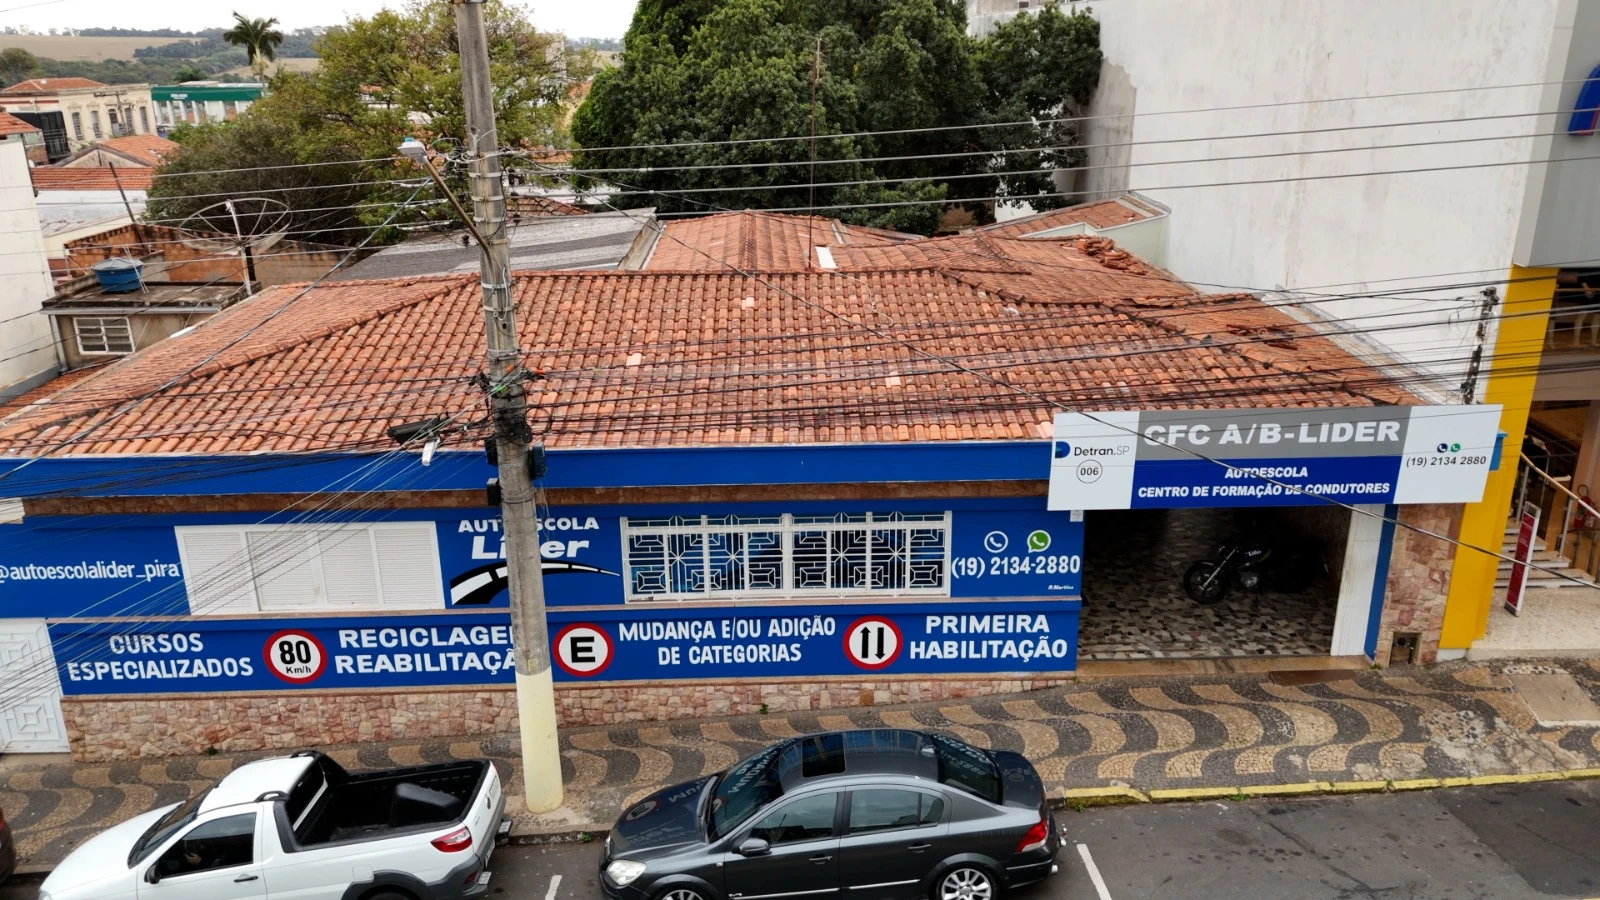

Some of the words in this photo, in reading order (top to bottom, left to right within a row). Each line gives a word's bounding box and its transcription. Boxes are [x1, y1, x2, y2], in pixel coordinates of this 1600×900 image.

[1143, 424, 1211, 446] CFC
[1073, 445, 1130, 456] Detran.SP
[1080, 467, 1099, 476] 006
[1224, 466, 1308, 478] AUTOESCOLA
[1406, 457, 1427, 468] (19)
[1430, 457, 1456, 466] 2134
[1460, 456, 1487, 465] 2880
[1138, 486, 1187, 498] CENTRO
[1192, 486, 1209, 497] DE
[1212, 482, 1280, 498] FORMAÇÃO
[1281, 484, 1301, 495] DE
[1305, 482, 1390, 495] CONDUTORES
[951, 556, 986, 579] (19)
[990, 555, 1081, 576] 2134-2880
[618, 620, 716, 643] MUDANÇA
[721, 617, 762, 641] E/OU
[767, 615, 836, 640] ADIÇÃO
[925, 614, 1050, 634] PRIMEIRA
[109, 633, 204, 655] CURSOS
[338, 625, 514, 648] RECICLAGE
[279, 640, 311, 664] 80
[570, 636, 596, 663] E
[658, 646, 681, 665] DE
[688, 643, 802, 665] CATEGORIAS
[909, 636, 1068, 662] HABILITAÇÃO
[67, 657, 254, 682] ESPECIALIZADOS
[286, 666, 311, 674] Km/h
